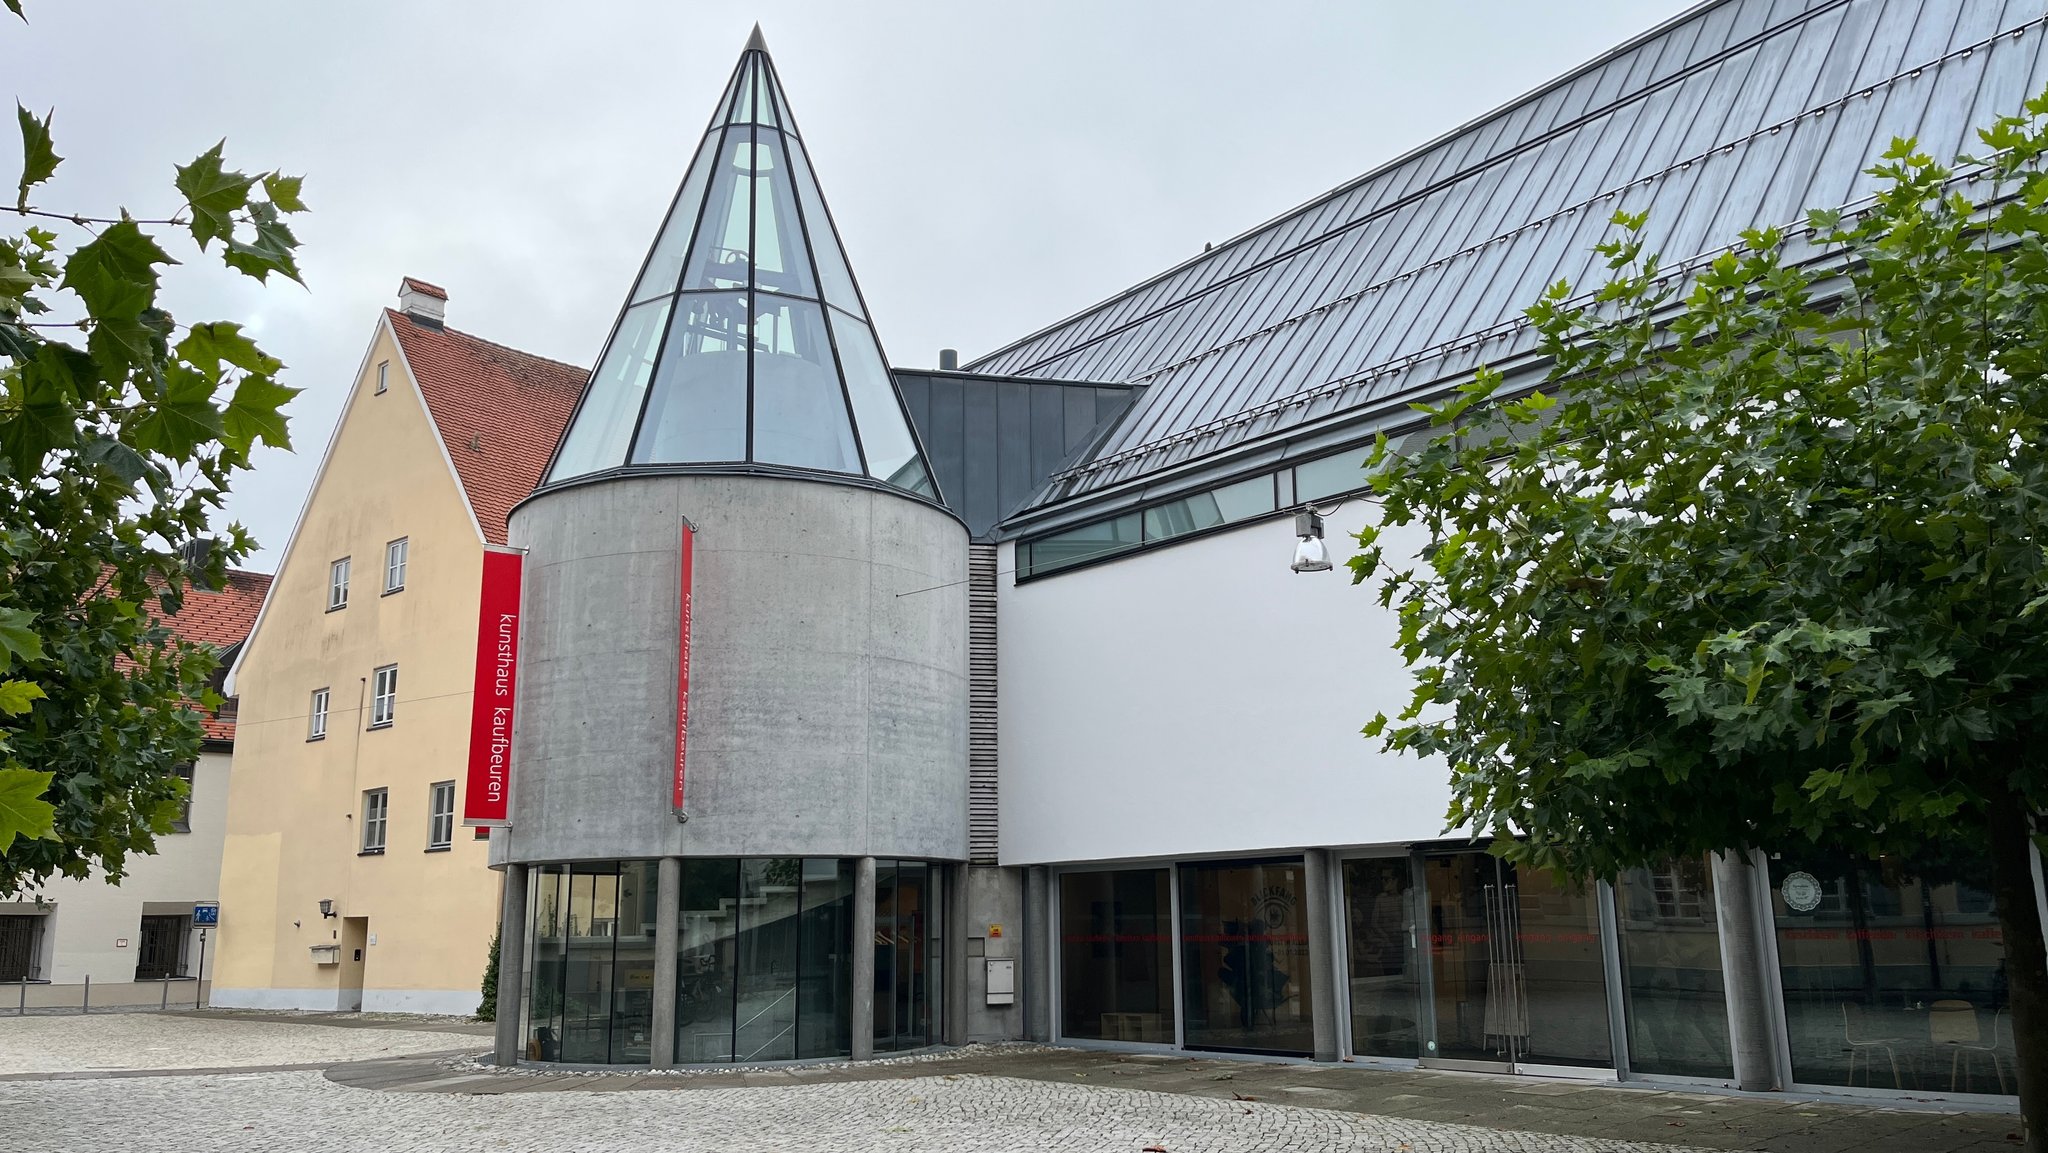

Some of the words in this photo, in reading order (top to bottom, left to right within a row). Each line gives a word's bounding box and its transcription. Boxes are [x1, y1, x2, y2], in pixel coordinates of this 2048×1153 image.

[496, 613, 516, 696] kunsthaus
[683, 593, 691, 679] kunsthaus
[488, 707, 511, 802] kaufbeuren
[678, 691, 688, 791] kaufbeuren
[1457, 931, 1491, 944] eingan
